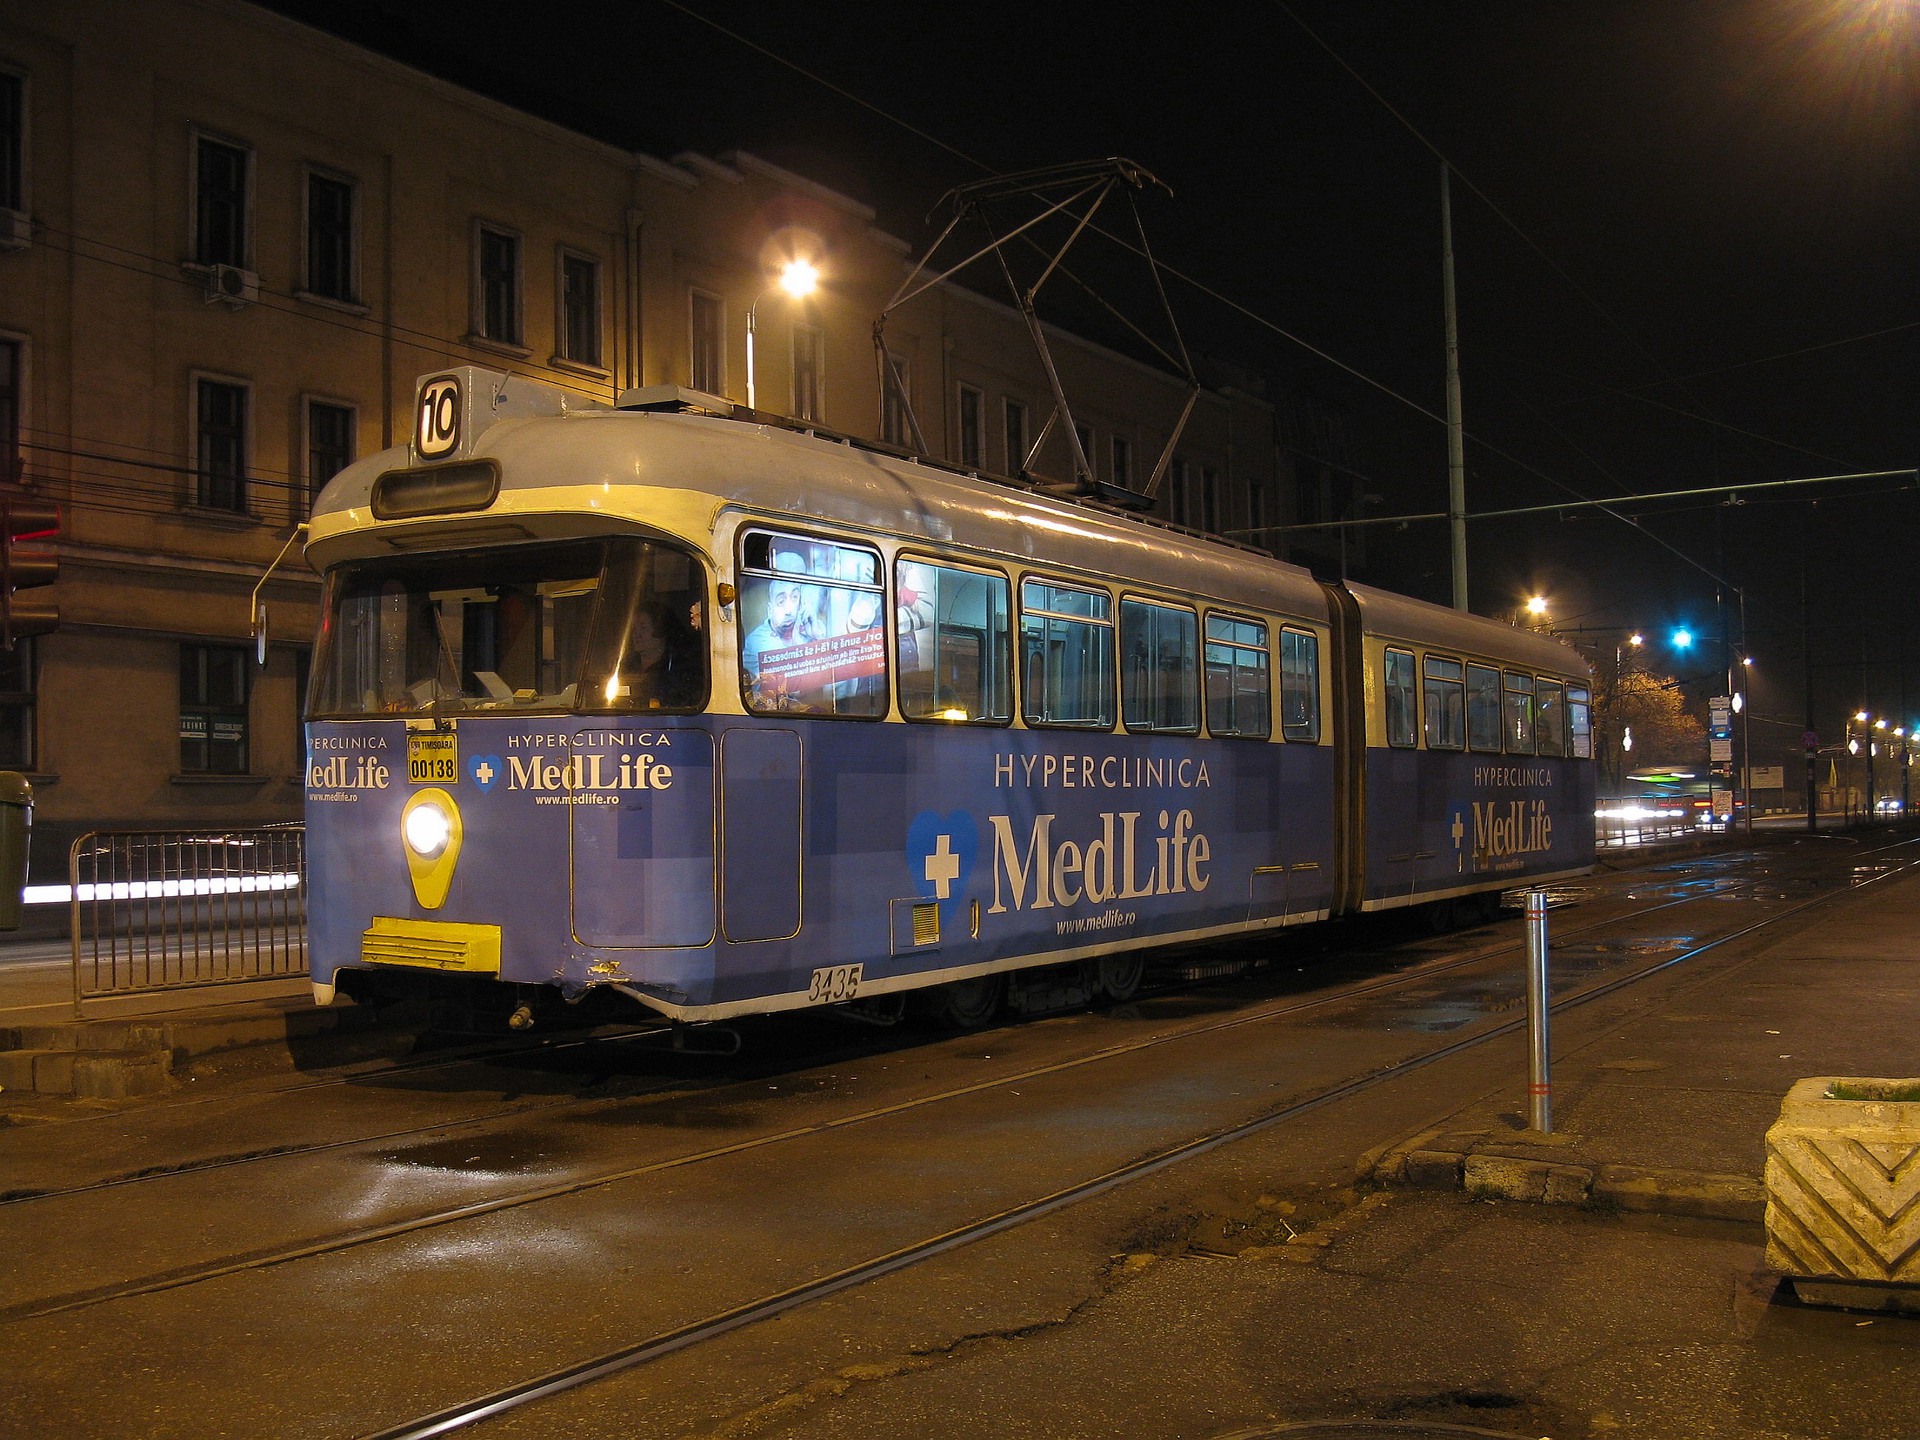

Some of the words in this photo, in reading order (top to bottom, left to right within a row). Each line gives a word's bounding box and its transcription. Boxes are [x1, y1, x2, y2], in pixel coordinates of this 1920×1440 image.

[424, 387, 457, 443] 10
[508, 733, 671, 748] HYPERCLINICA
[411, 759, 454, 779] 00138
[506, 753, 674, 790] MedLife
[993, 753, 1211, 788] HYPERCLINICA
[1474, 766, 1552, 787] HYPERCLINICA
[309, 791, 358, 802] www.medlife.ro
[535, 793, 620, 805] www.medlife.ro
[1471, 799, 1552, 858] MedLife
[986, 808, 1211, 914] MedLife
[1056, 909, 1137, 936] www.medlife.ro
[808, 967, 860, 1002] 3435
